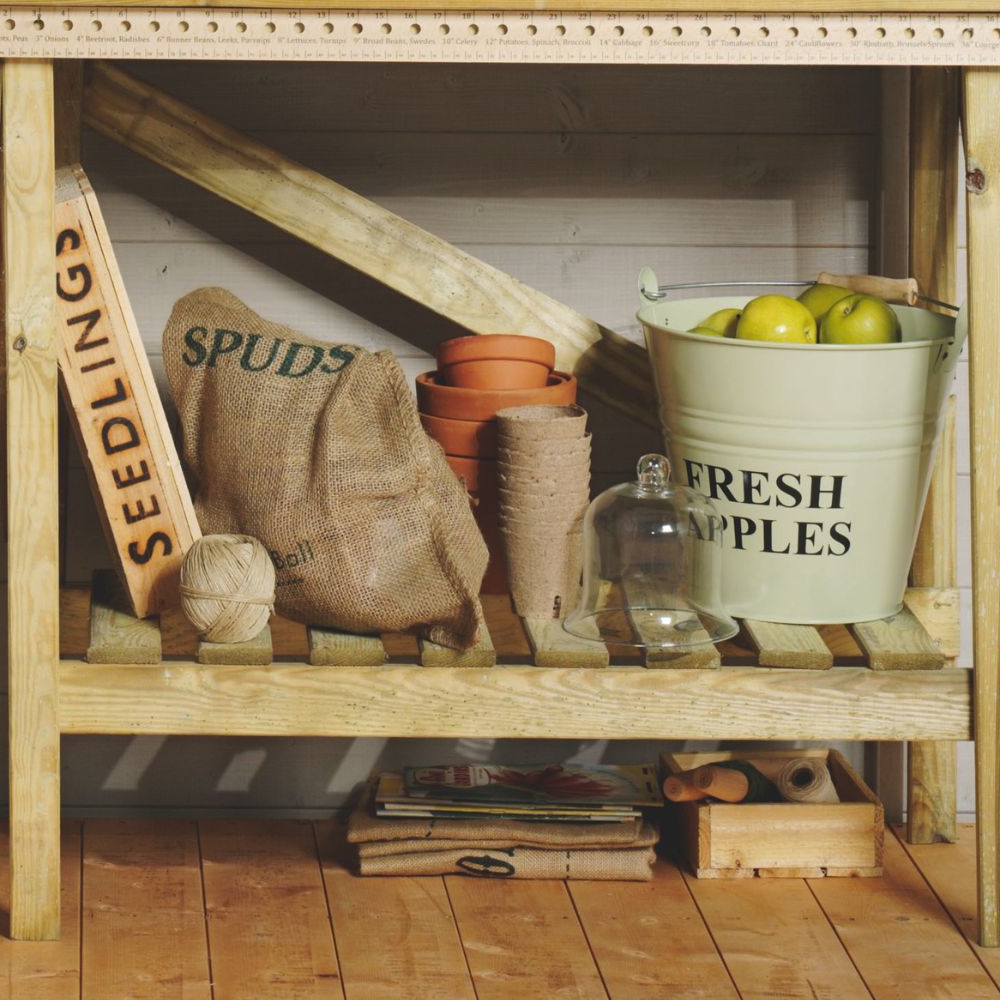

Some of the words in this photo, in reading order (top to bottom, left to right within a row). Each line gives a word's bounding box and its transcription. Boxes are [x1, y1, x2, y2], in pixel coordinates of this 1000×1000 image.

[85, 35, 117, 43] Beetroot,
[241, 36, 271, 45] Parsnips
[320, 37, 346, 46] Turnips
[455, 37, 477, 46] Celery
[612, 38, 642, 47] Cabbage
[182, 326, 366, 379] SPUDS
[56, 227, 173, 566] SEEDLINGS
[682, 458, 848, 509] FRESH
[687, 513, 852, 557] APPLES
